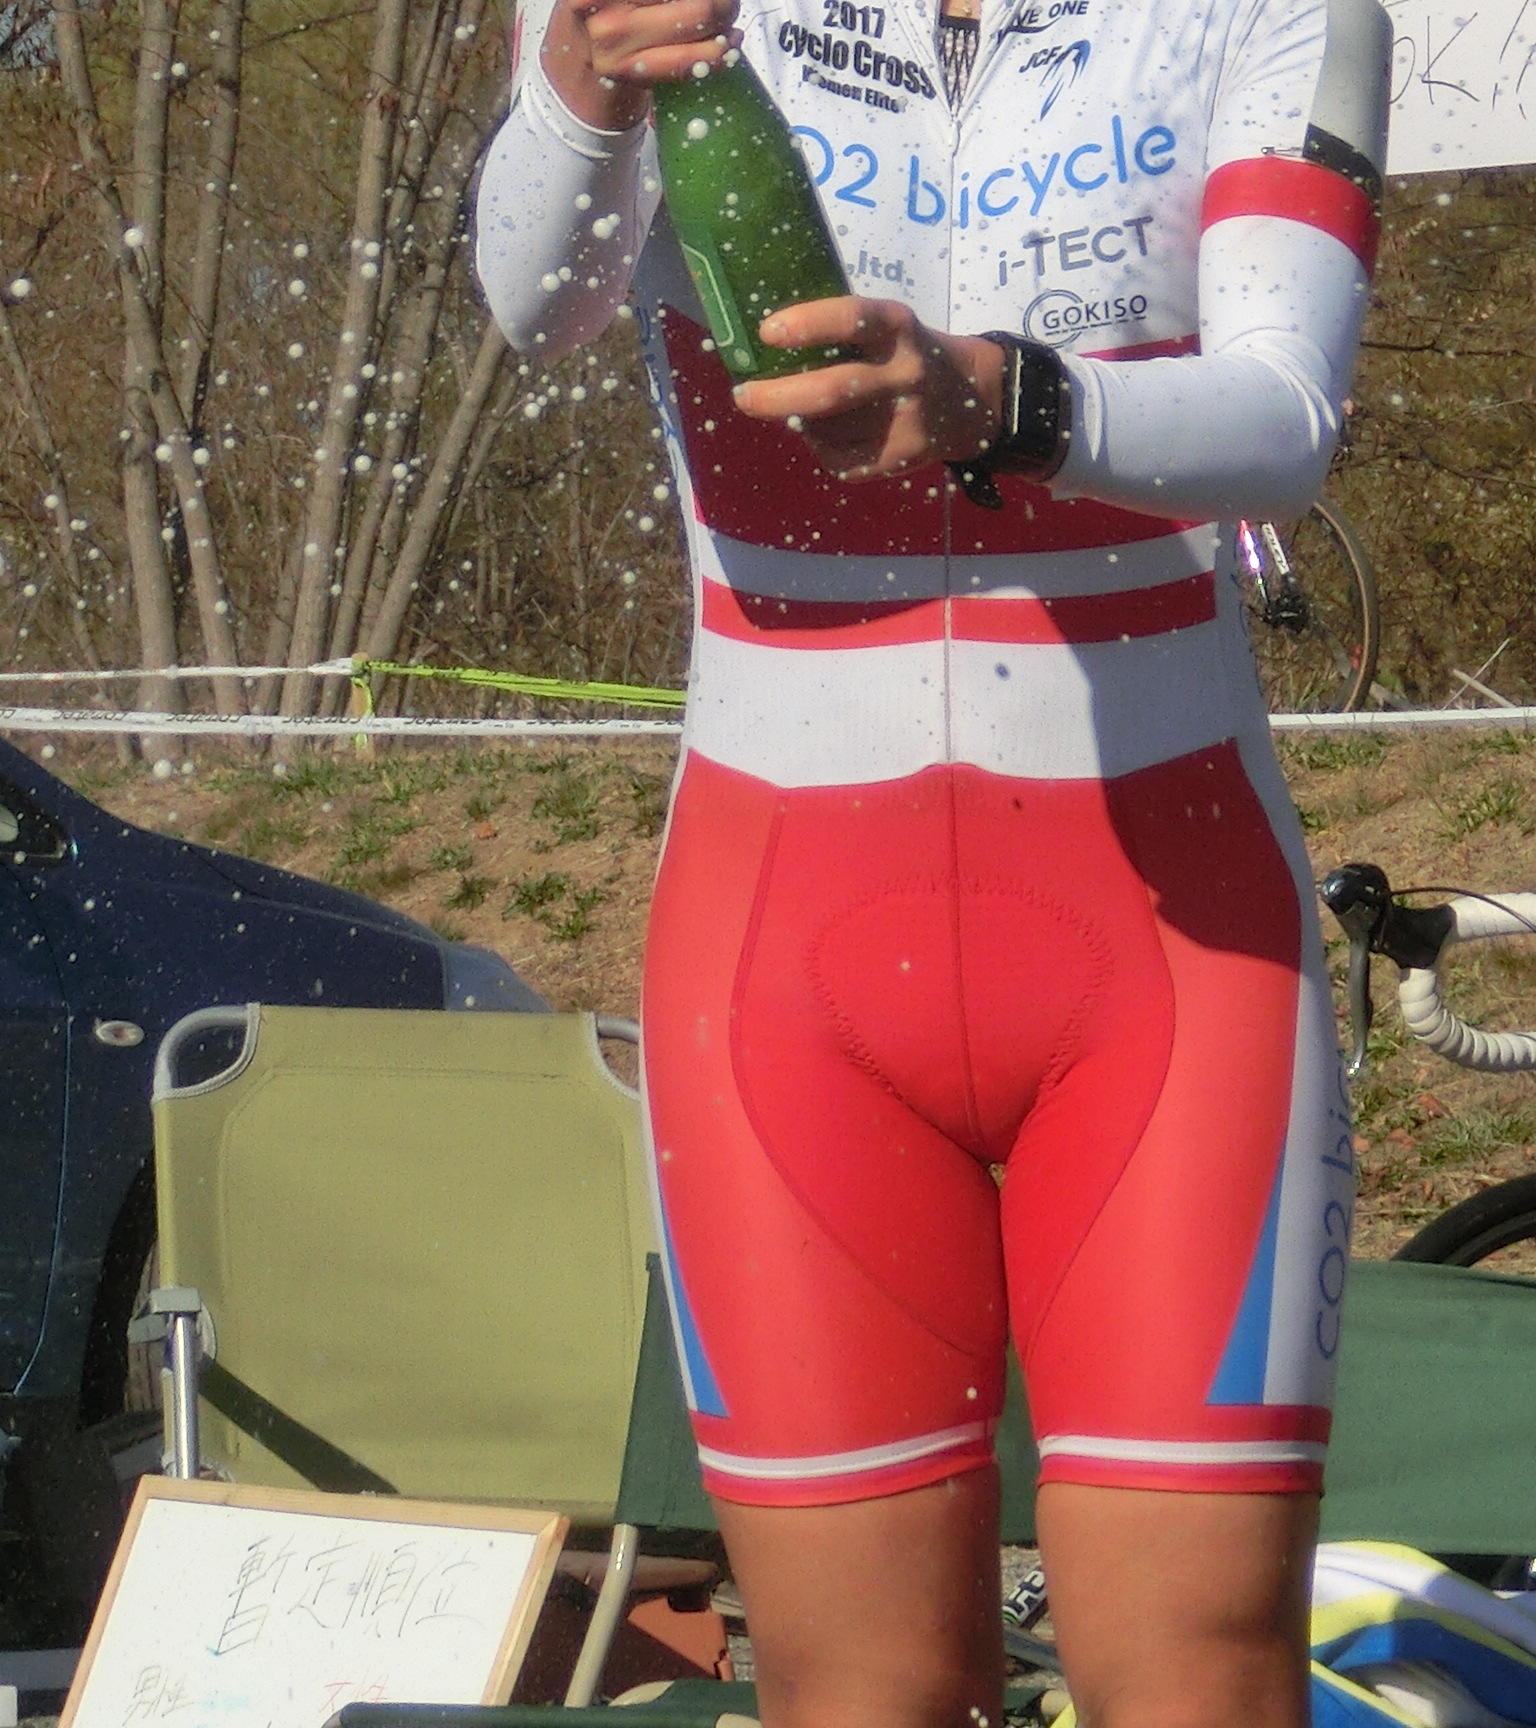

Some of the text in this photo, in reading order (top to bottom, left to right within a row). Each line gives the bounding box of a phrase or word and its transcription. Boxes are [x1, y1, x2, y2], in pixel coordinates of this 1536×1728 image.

[1048, 0, 1090, 19] ONE
[778, 19, 938, 101] Cyclo Cross
[1018, 44, 1064, 74] JCF
[788, 114, 1177, 230] O2 bicycle
[998, 215, 1155, 288] i-TECT
[1043, 294, 1148, 330] GOKISO
